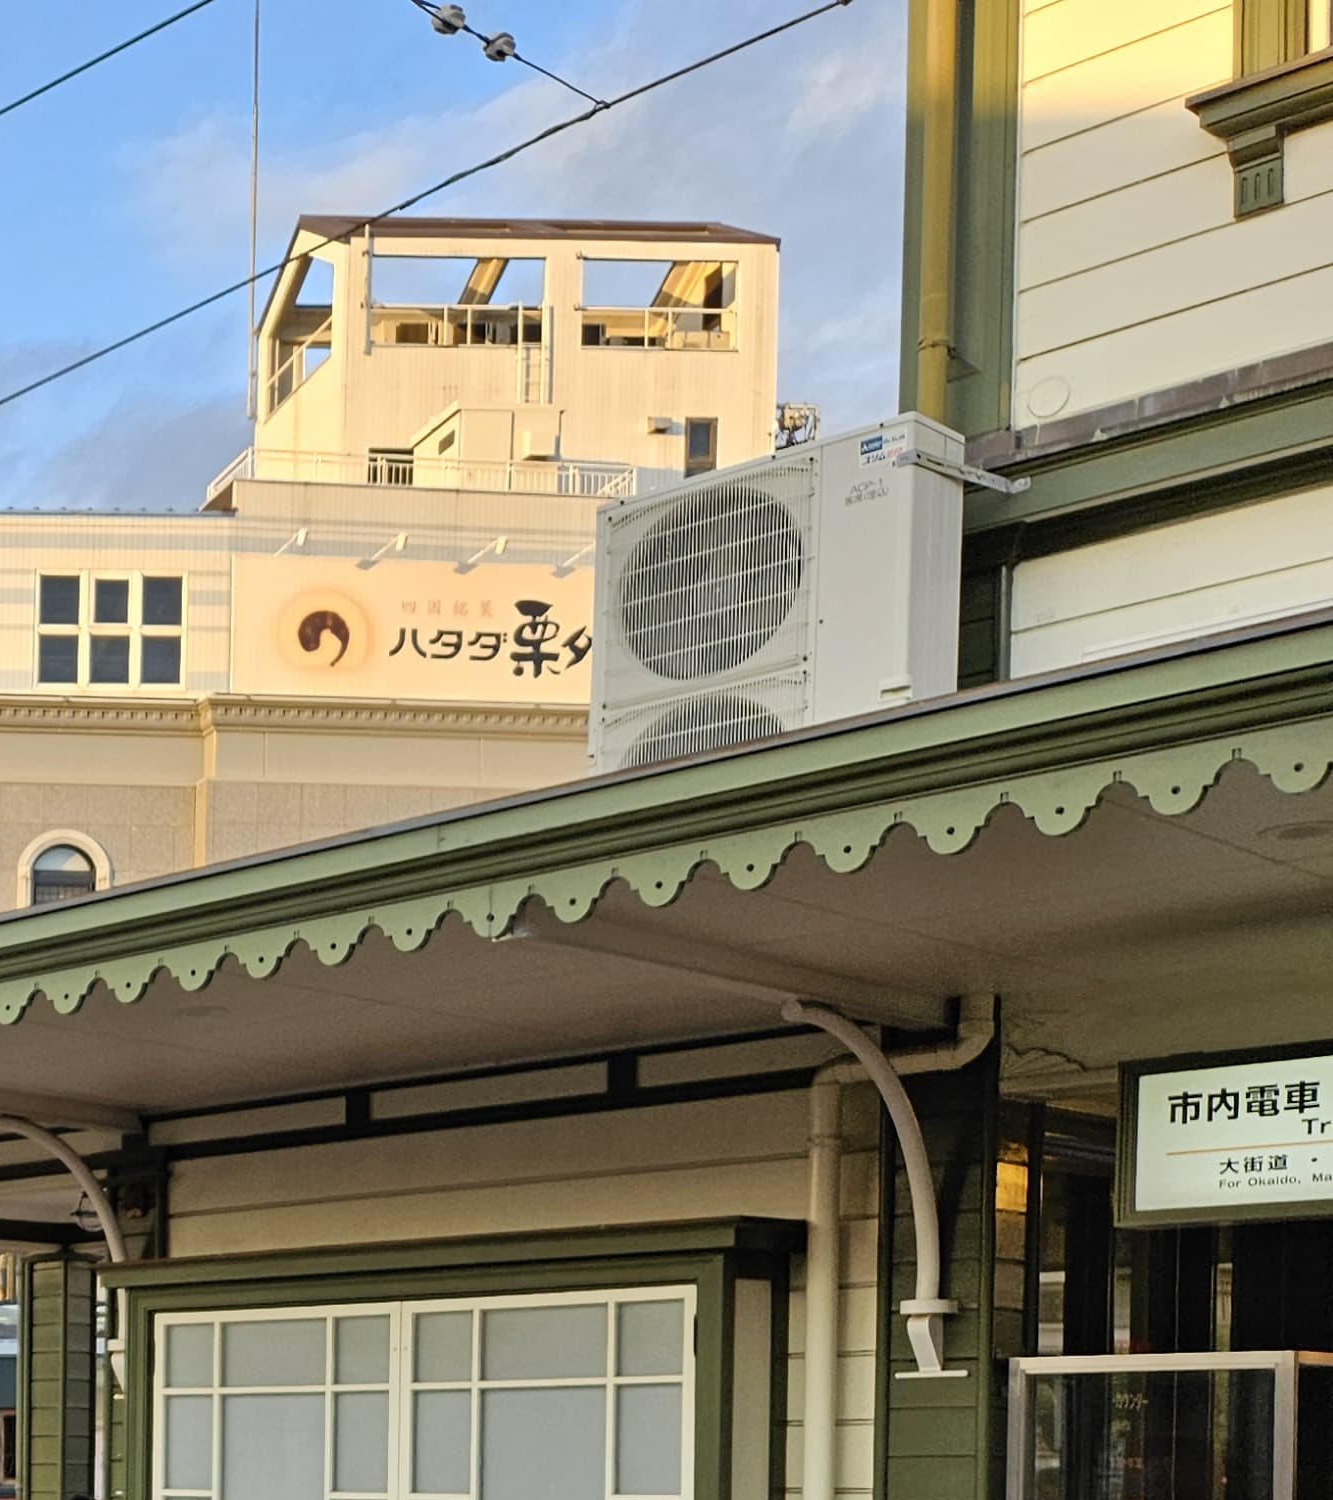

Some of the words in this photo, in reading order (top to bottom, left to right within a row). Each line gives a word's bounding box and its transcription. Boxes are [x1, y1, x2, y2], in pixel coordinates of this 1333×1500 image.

[1168, 1081, 1320, 1124] 市内電車
[1219, 1155, 1288, 1175] 大街道
